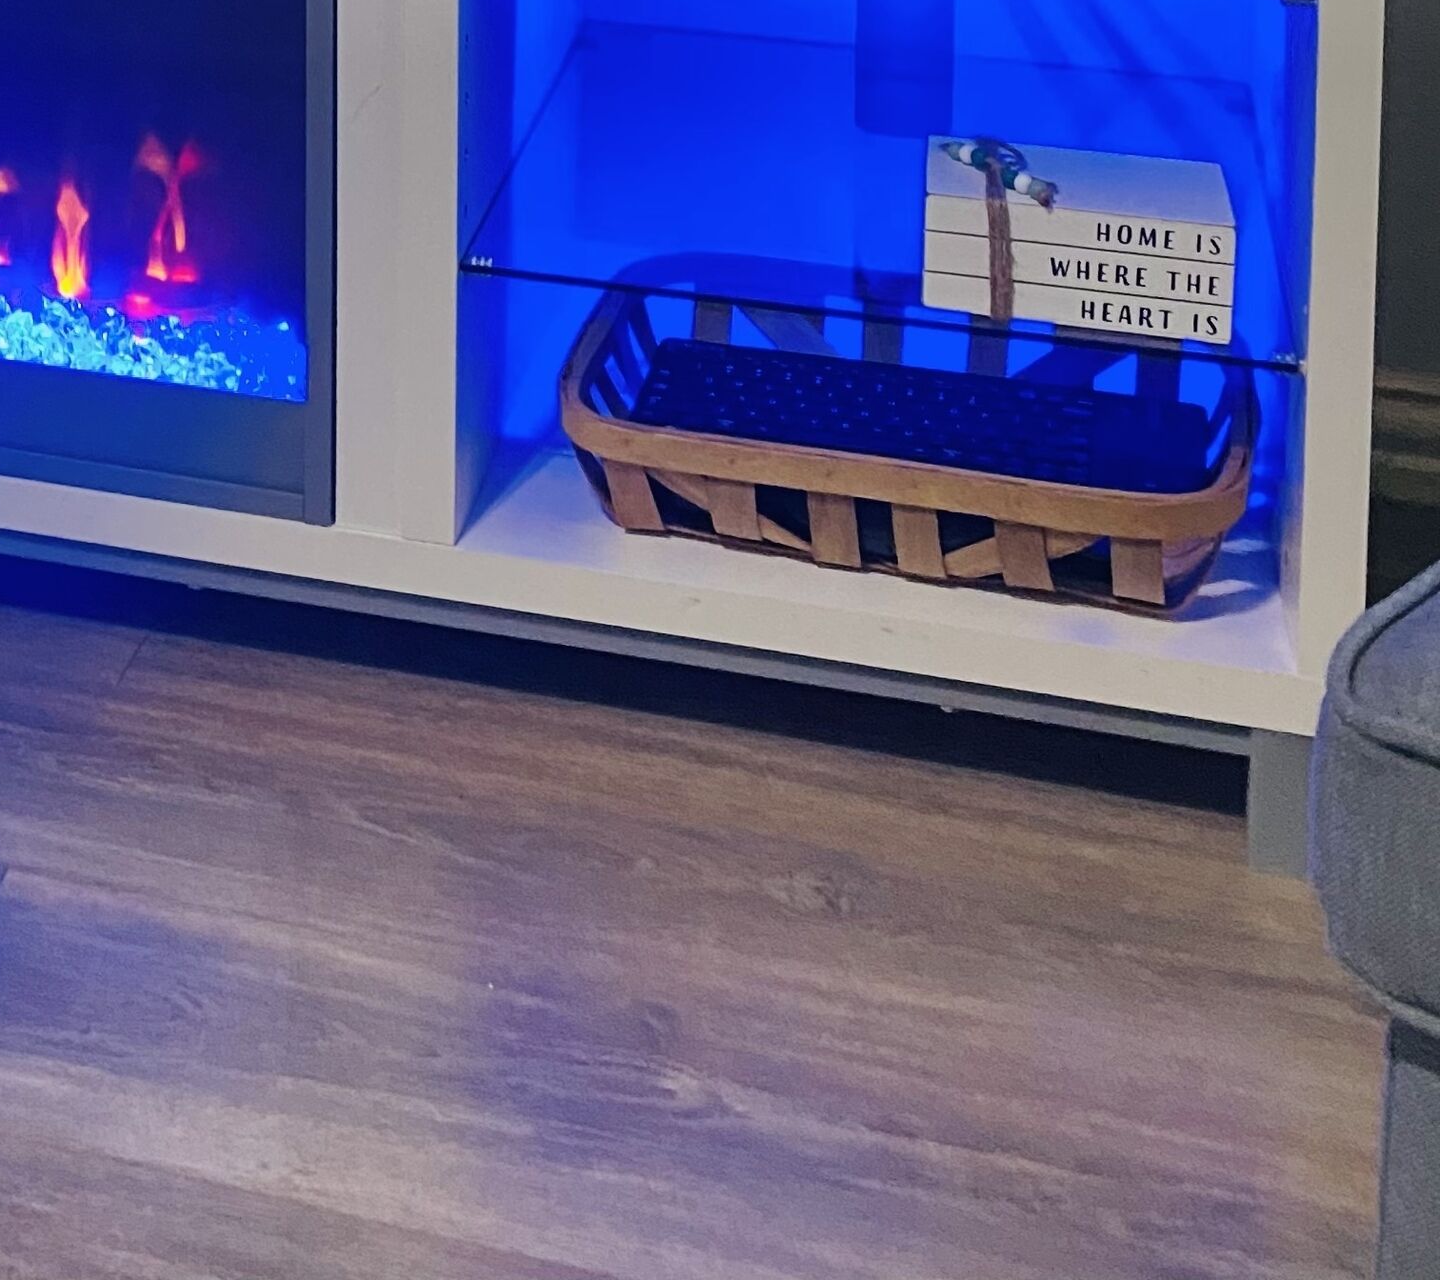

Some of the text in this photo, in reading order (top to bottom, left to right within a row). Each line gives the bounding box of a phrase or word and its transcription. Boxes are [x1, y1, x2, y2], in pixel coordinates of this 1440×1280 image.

[1097, 222, 1222, 256] HOME IS
[1050, 256, 1221, 297] WHERE THE
[1081, 299, 1219, 337] HEART IS
